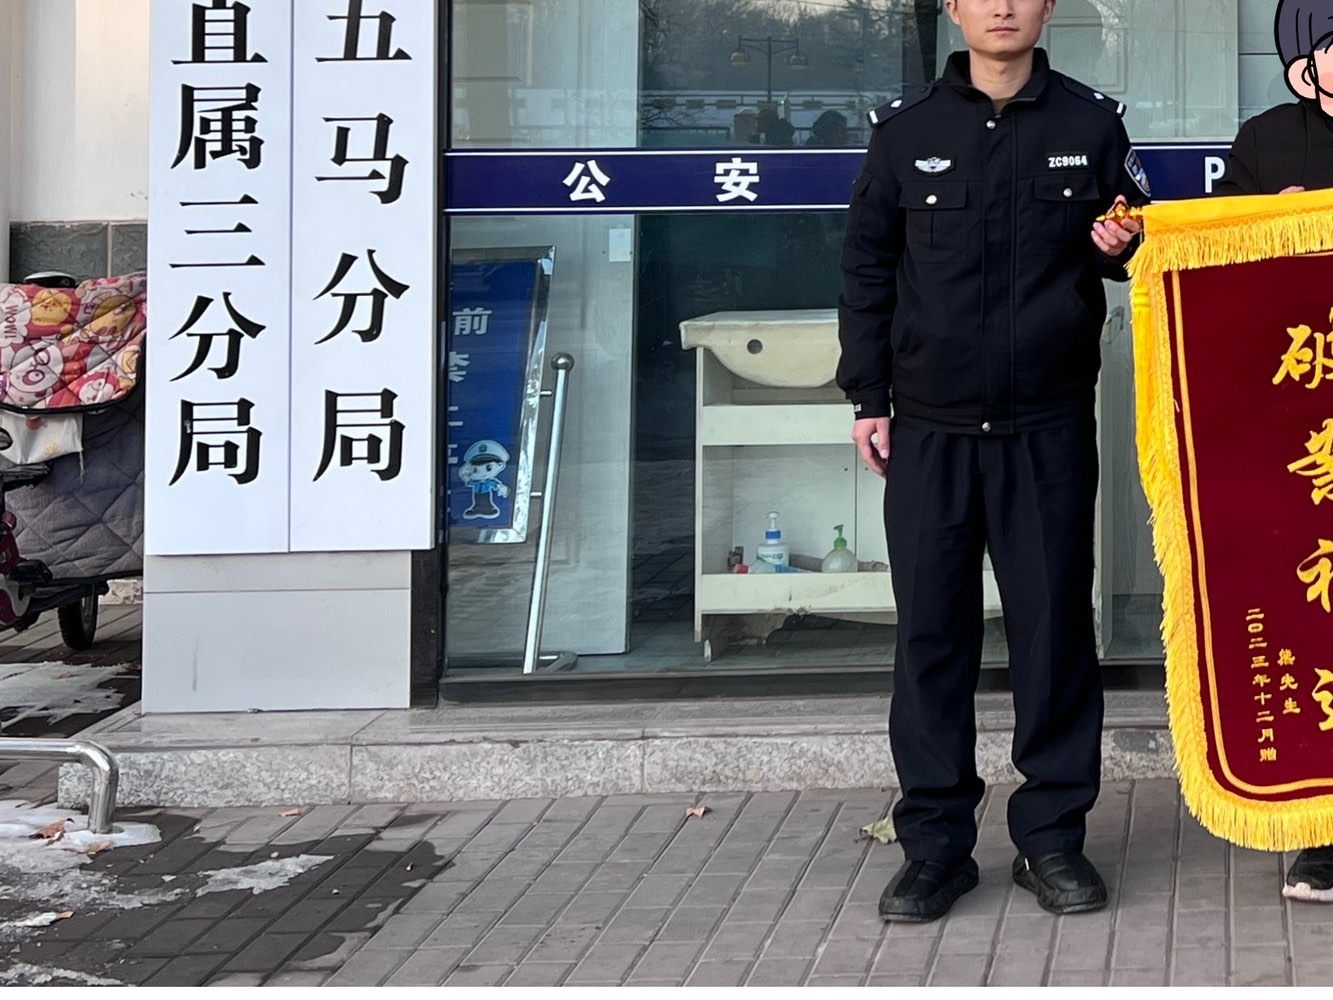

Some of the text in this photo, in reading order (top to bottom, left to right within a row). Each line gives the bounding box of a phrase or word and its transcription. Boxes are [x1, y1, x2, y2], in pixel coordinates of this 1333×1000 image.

[1048, 155, 1088, 168] ZC9064
[563, 157, 761, 203] 公安
[453, 307, 492, 335] 前
